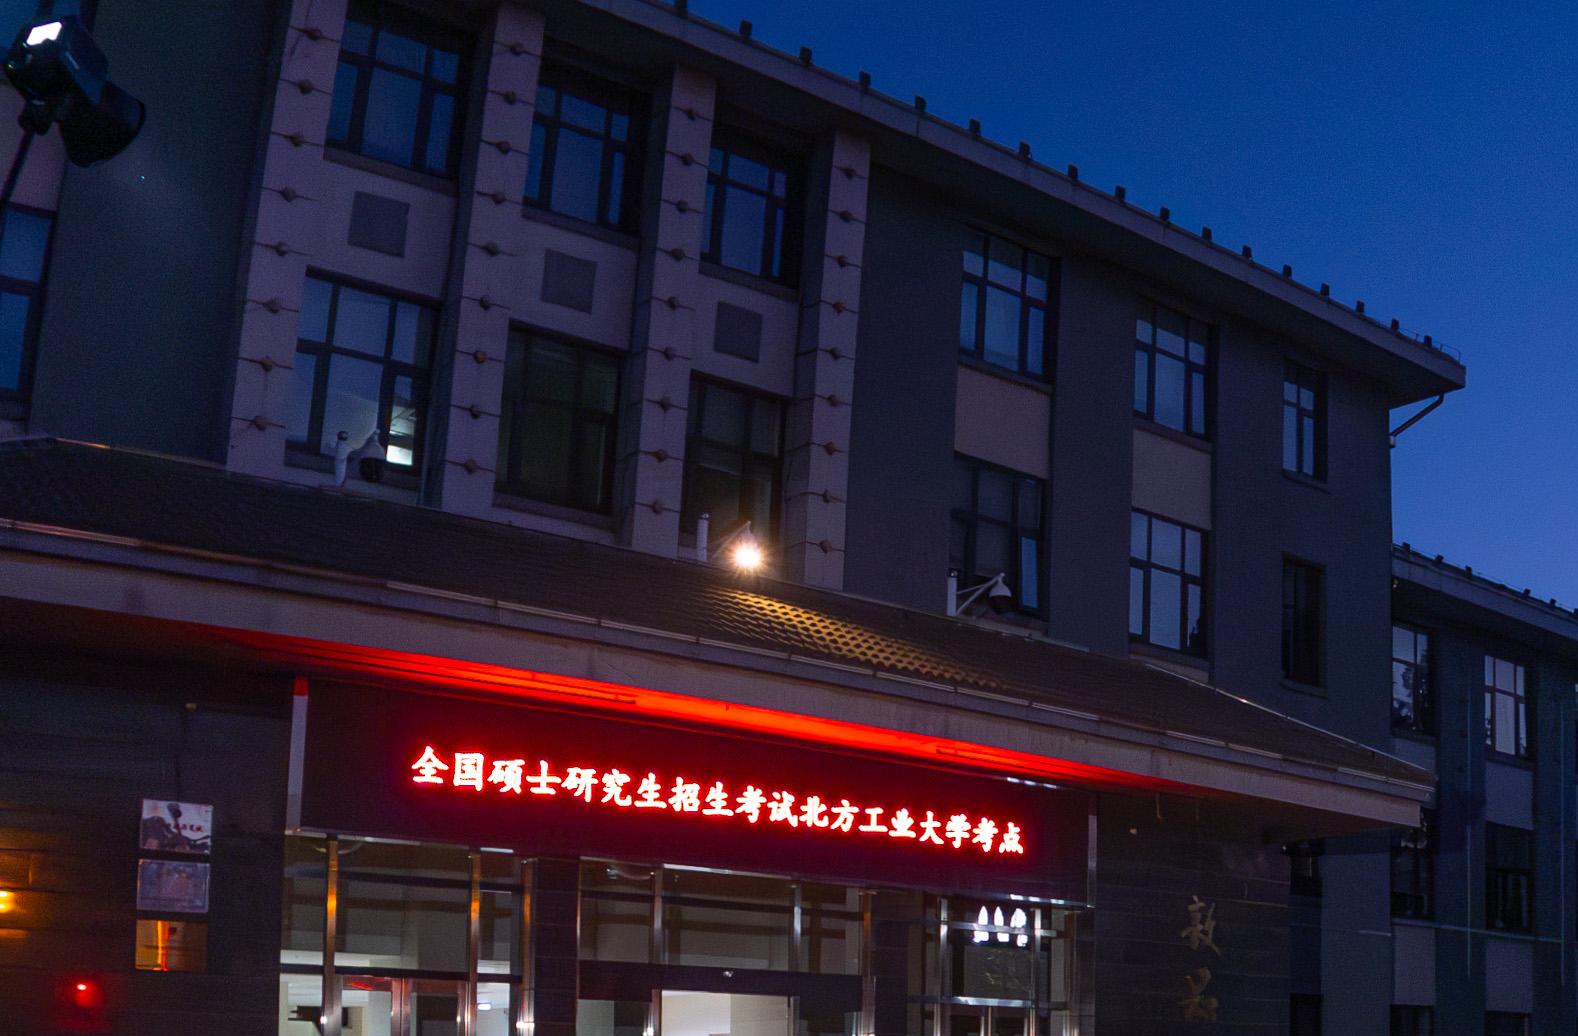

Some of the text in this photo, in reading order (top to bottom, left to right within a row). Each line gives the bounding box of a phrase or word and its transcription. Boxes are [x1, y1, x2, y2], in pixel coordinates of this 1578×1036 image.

[410, 745, 1024, 855] 全国硕士研究生招生考试北方工业大学考点
